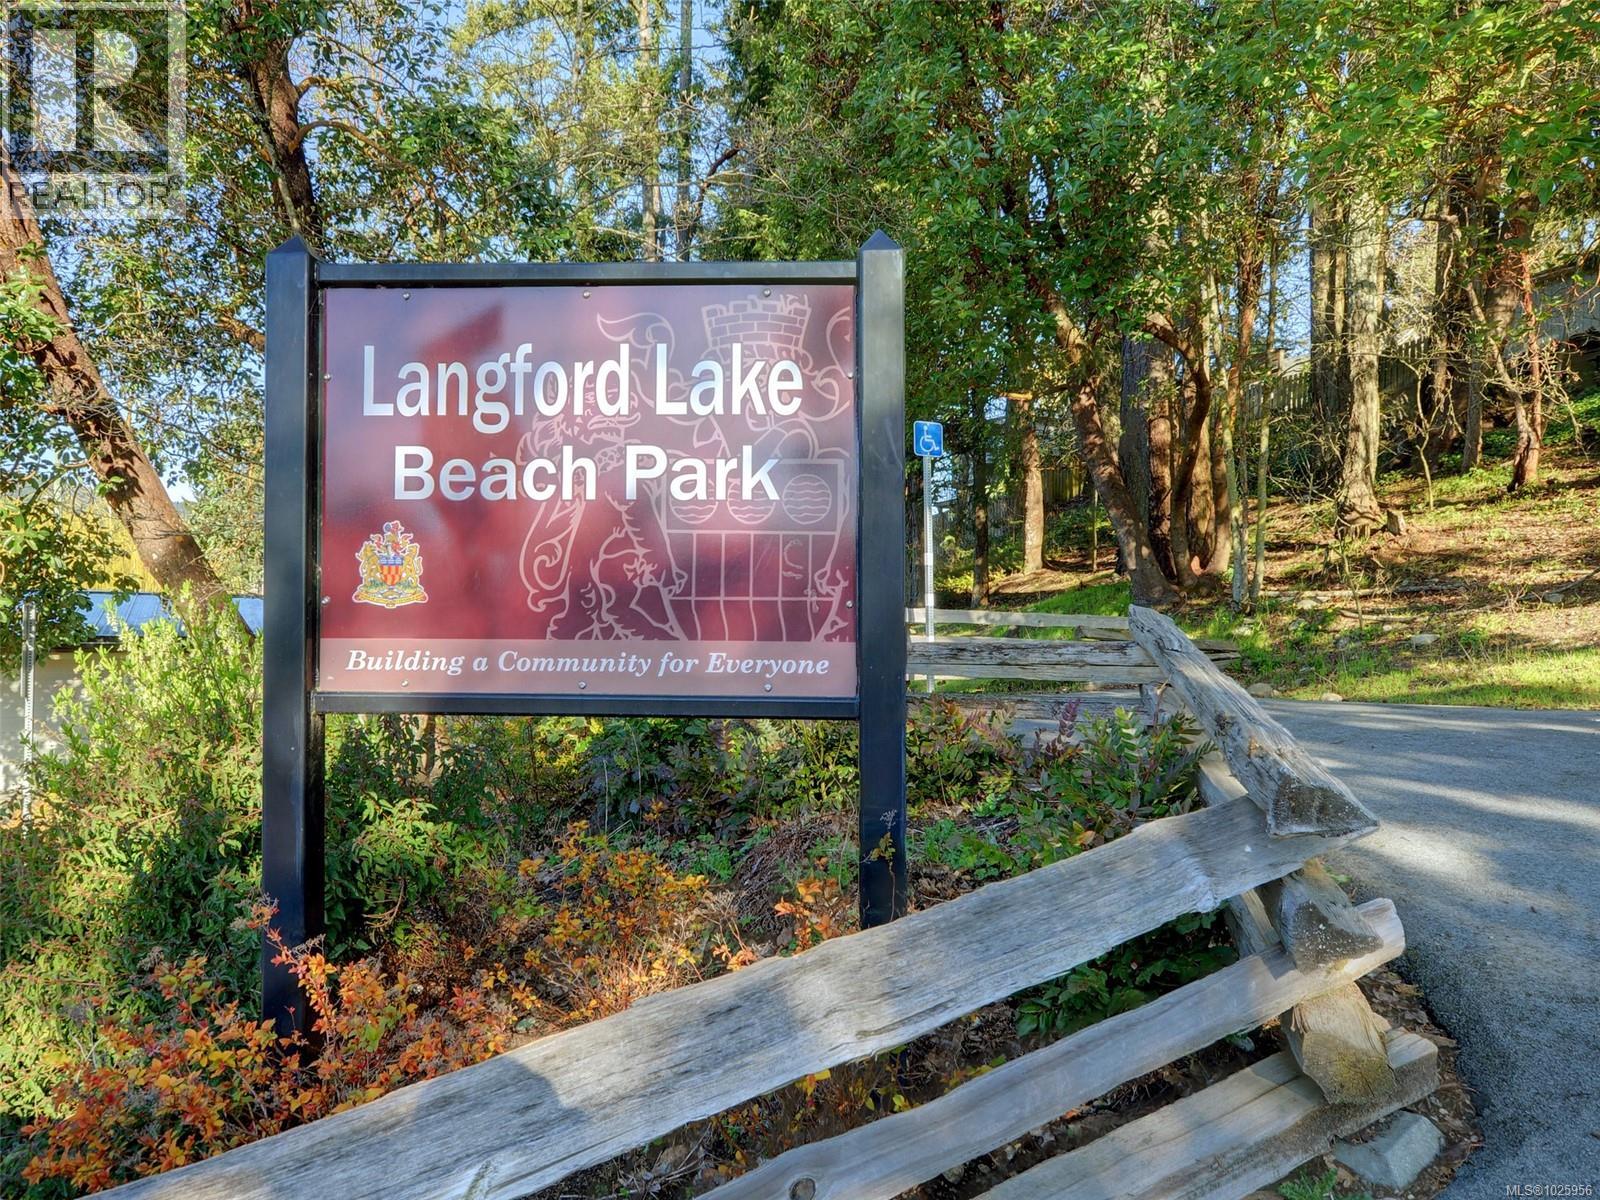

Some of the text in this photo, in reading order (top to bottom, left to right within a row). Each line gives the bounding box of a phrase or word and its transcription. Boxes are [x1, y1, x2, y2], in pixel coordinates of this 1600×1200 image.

[362, 343, 804, 434] Langford Lake
[393, 444, 781, 501] Beach Park
[345, 649, 830, 678] Building a Community for Everyone
